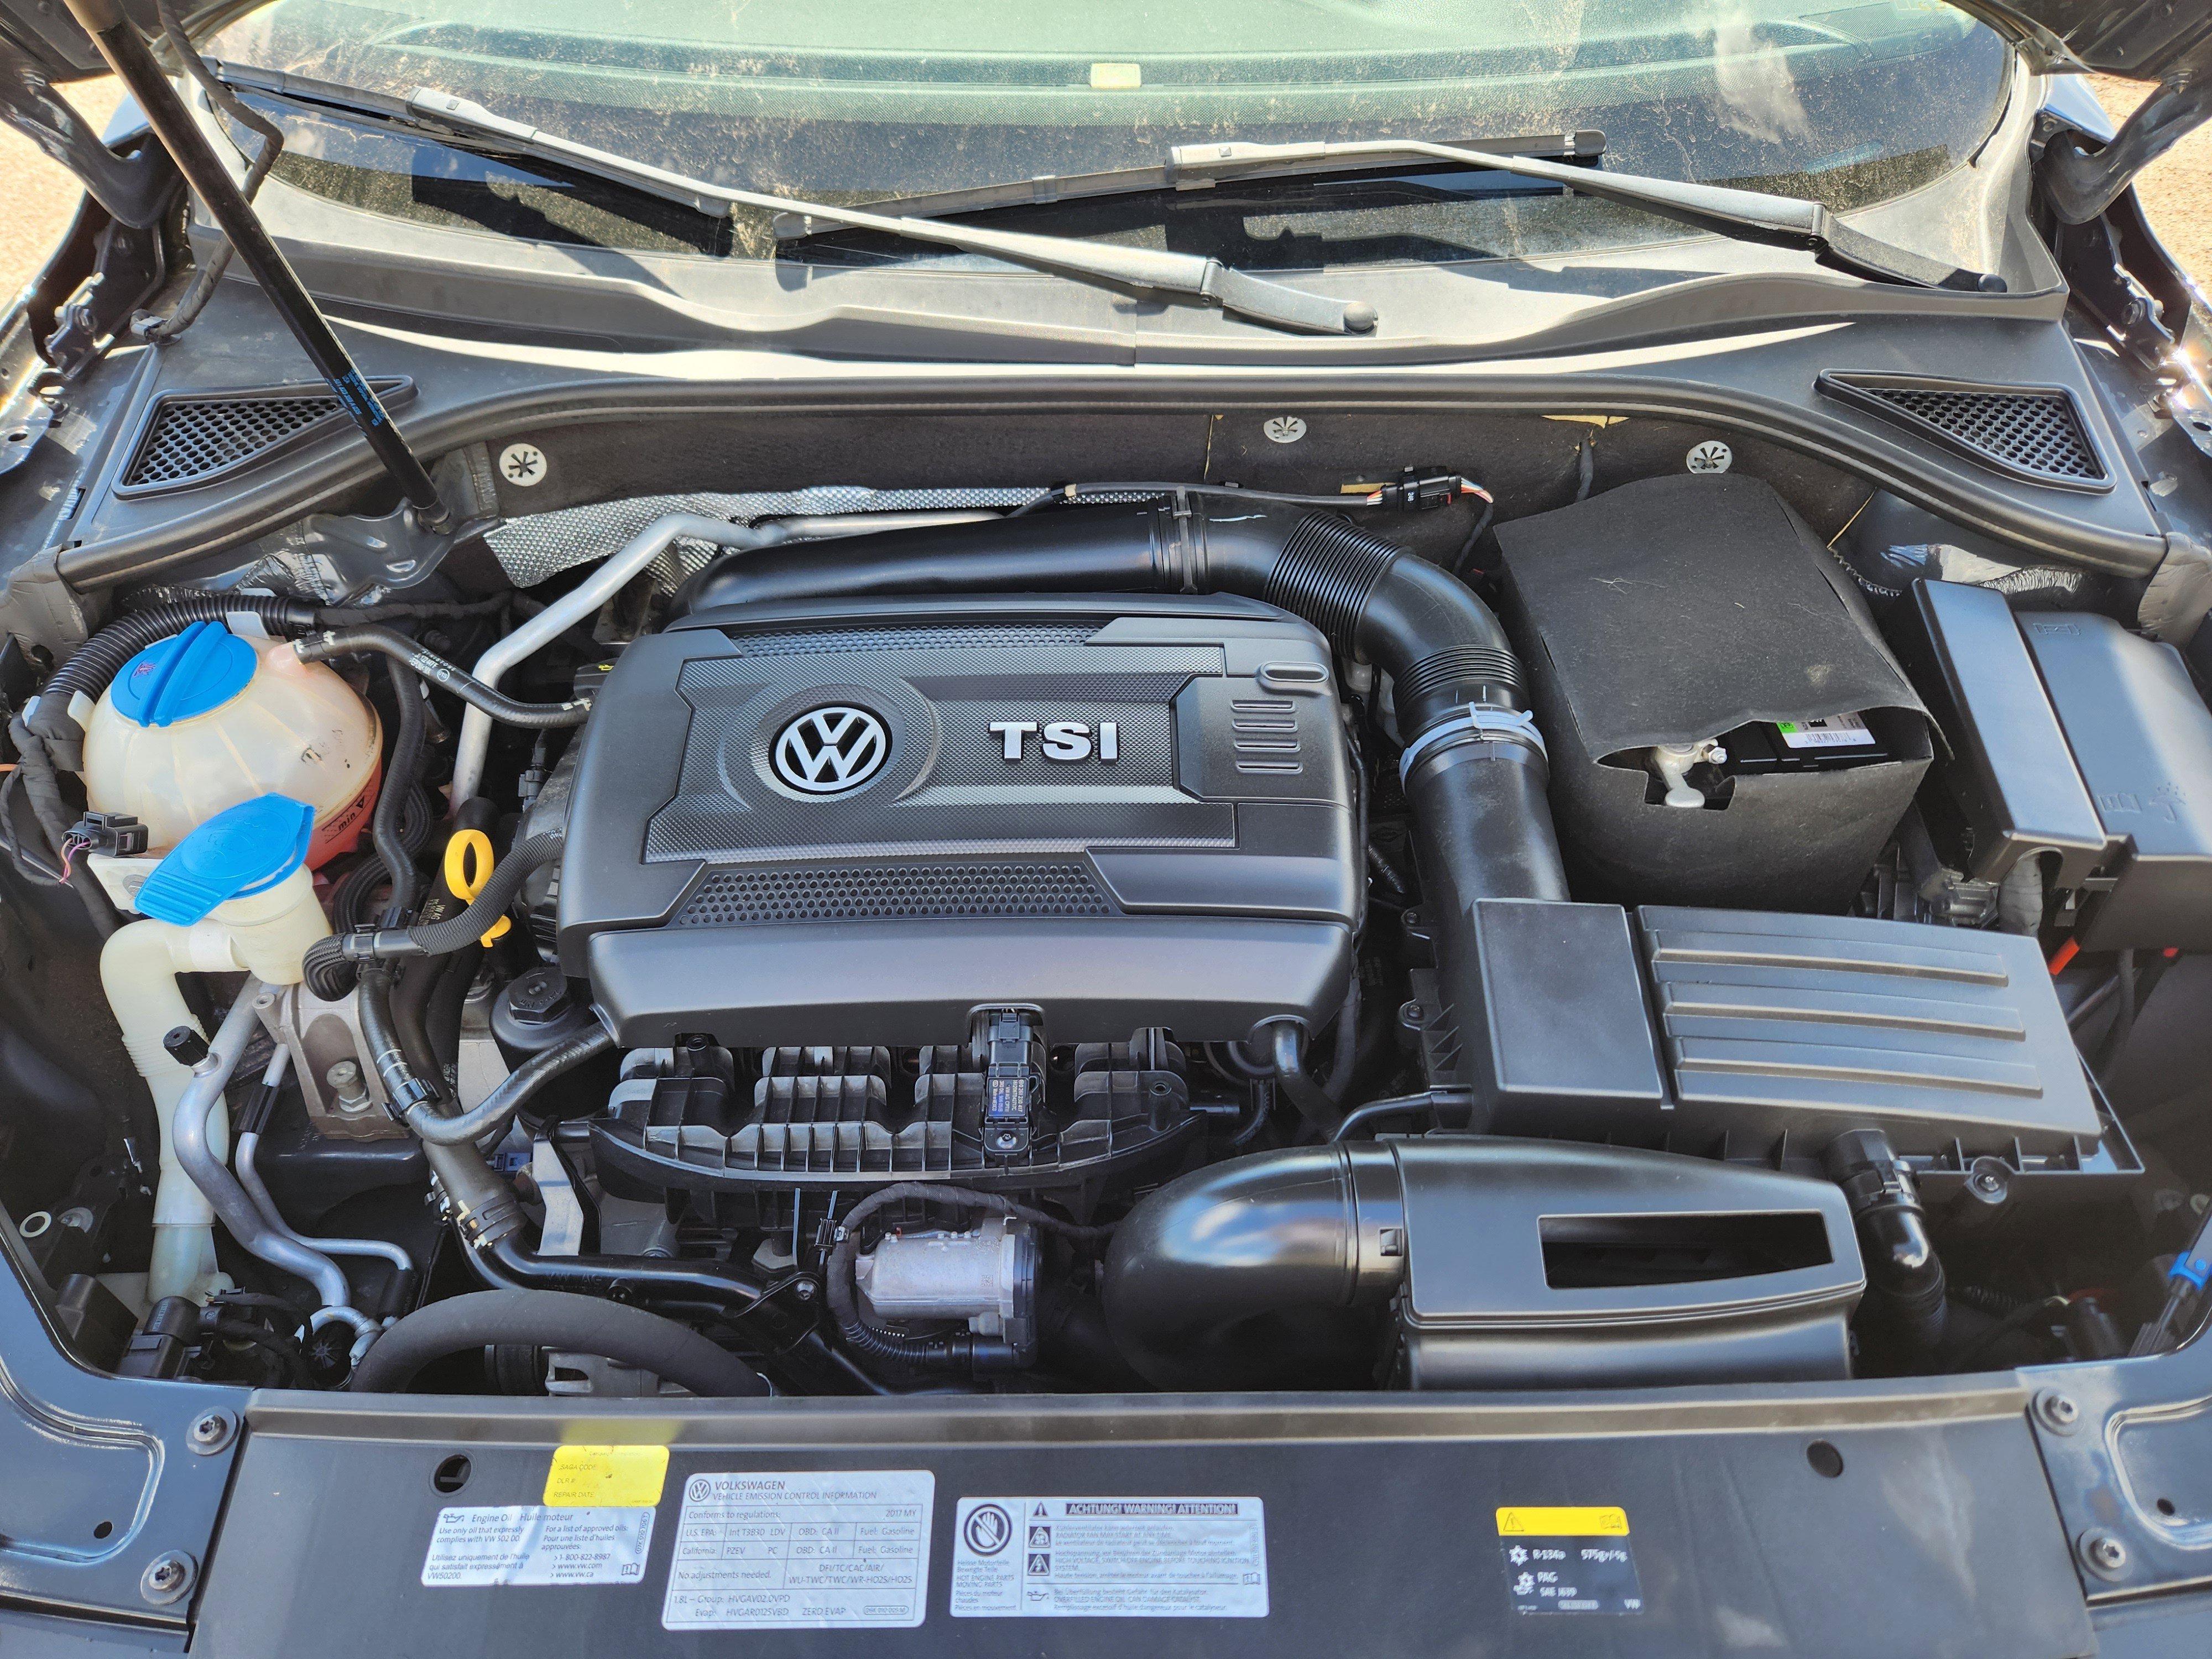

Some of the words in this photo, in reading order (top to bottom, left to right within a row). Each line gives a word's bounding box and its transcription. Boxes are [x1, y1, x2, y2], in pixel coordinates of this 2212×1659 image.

[989, 721, 1118, 761] TSI
[338, 812, 356, 831] min
[431, 912, 442, 920] AG
[582, 1273, 602, 1284] AG
[715, 1480, 785, 1490] VOLKSWAGEN
[822, 1491, 877, 1499] INFORMATION
[1068, 1503, 1122, 1514] ACHTUNG!
[1124, 1503, 1177, 1514] WARNING!
[1177, 1503, 1237, 1514] ATTENTION!
[472, 1514, 499, 1524] Engine
[737, 1510, 780, 1520] regulations:
[453, 1527, 468, 1535] only
[493, 1526, 524, 1535] expressly
[583, 1525, 613, 1533] approved
[799, 1527, 818, 1536] OBD:
[436, 1535, 466, 1544] complies
[458, 1554, 498, 1562] uniquement
[469, 1562, 518, 1572] expressément
[690, 1571, 739, 1580] adjustments
[742, 1571, 771, 1579] needed.
[1537, 1571, 1558, 1583] PAG
[697, 1595, 723, 1605] Group:
[695, 1609, 716, 1617] Evap:
[802, 1607, 823, 1615] ZERO
[825, 1606, 847, 1615] EVAP
